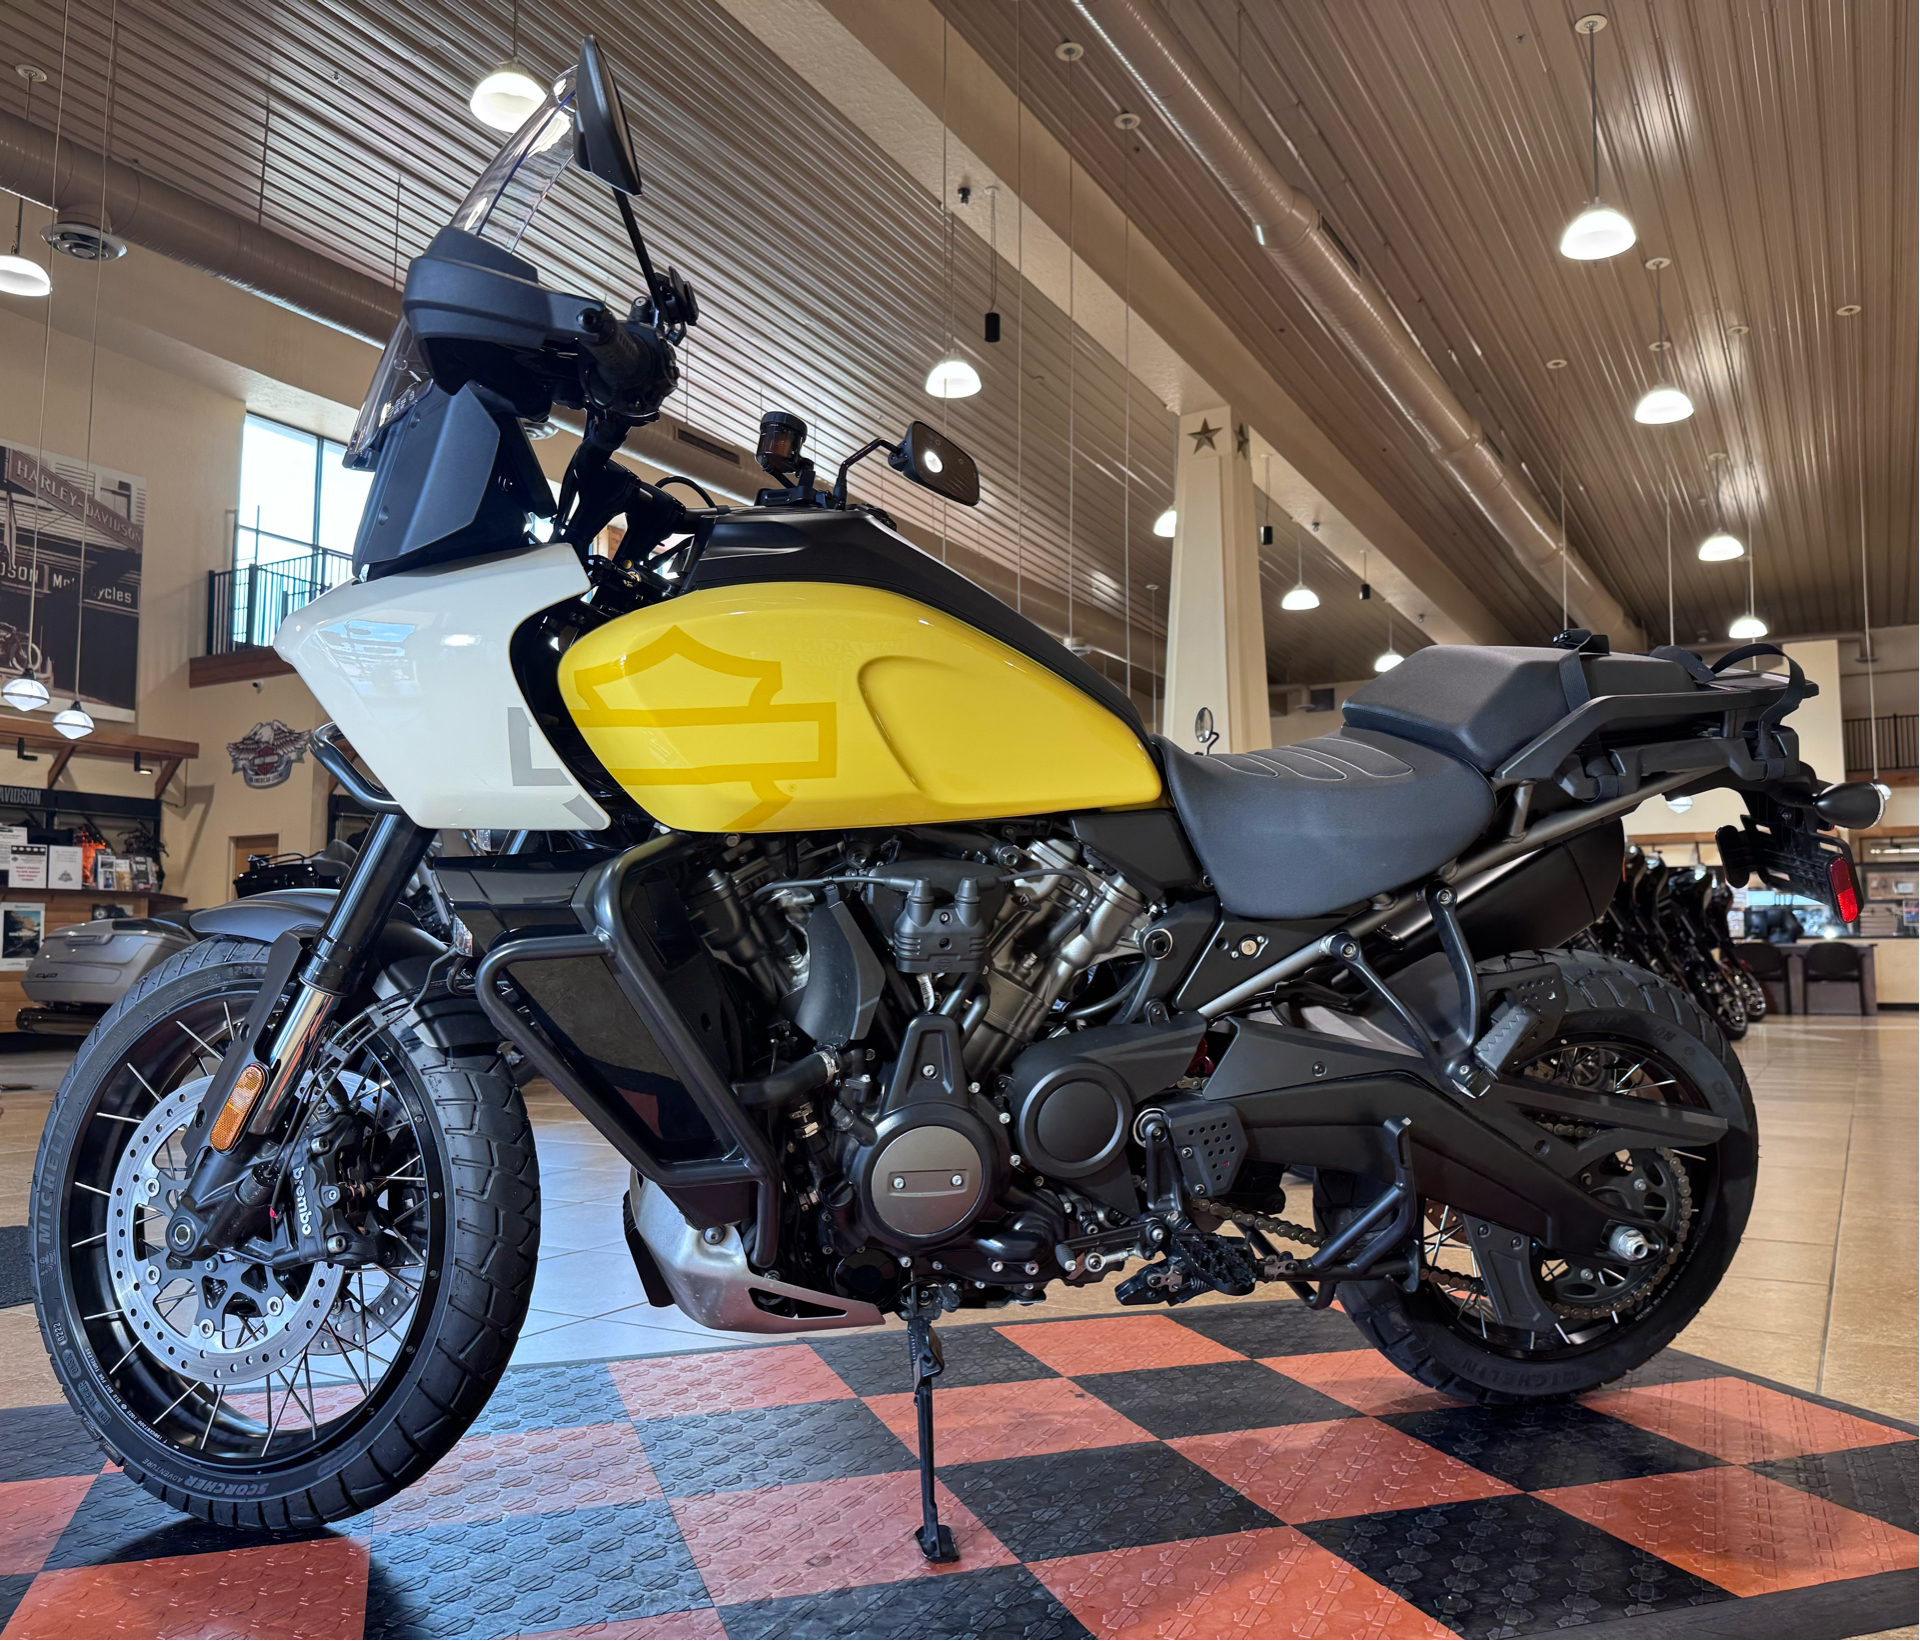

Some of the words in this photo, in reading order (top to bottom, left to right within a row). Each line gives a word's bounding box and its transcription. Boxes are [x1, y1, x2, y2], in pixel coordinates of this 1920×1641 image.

[16, 460, 141, 543] HARLEY-DAVIDSON
[37, 1100, 81, 1245] MICHELIN
[292, 1166, 312, 1235] brembo
[53, 1322, 67, 1343] 0222
[85, 1347, 101, 1373] TUBELESS
[1461, 1359, 1581, 1387] MICHELIN
[141, 1457, 184, 1483] ADVENTURE
[184, 1474, 270, 1496] SCORCHER
